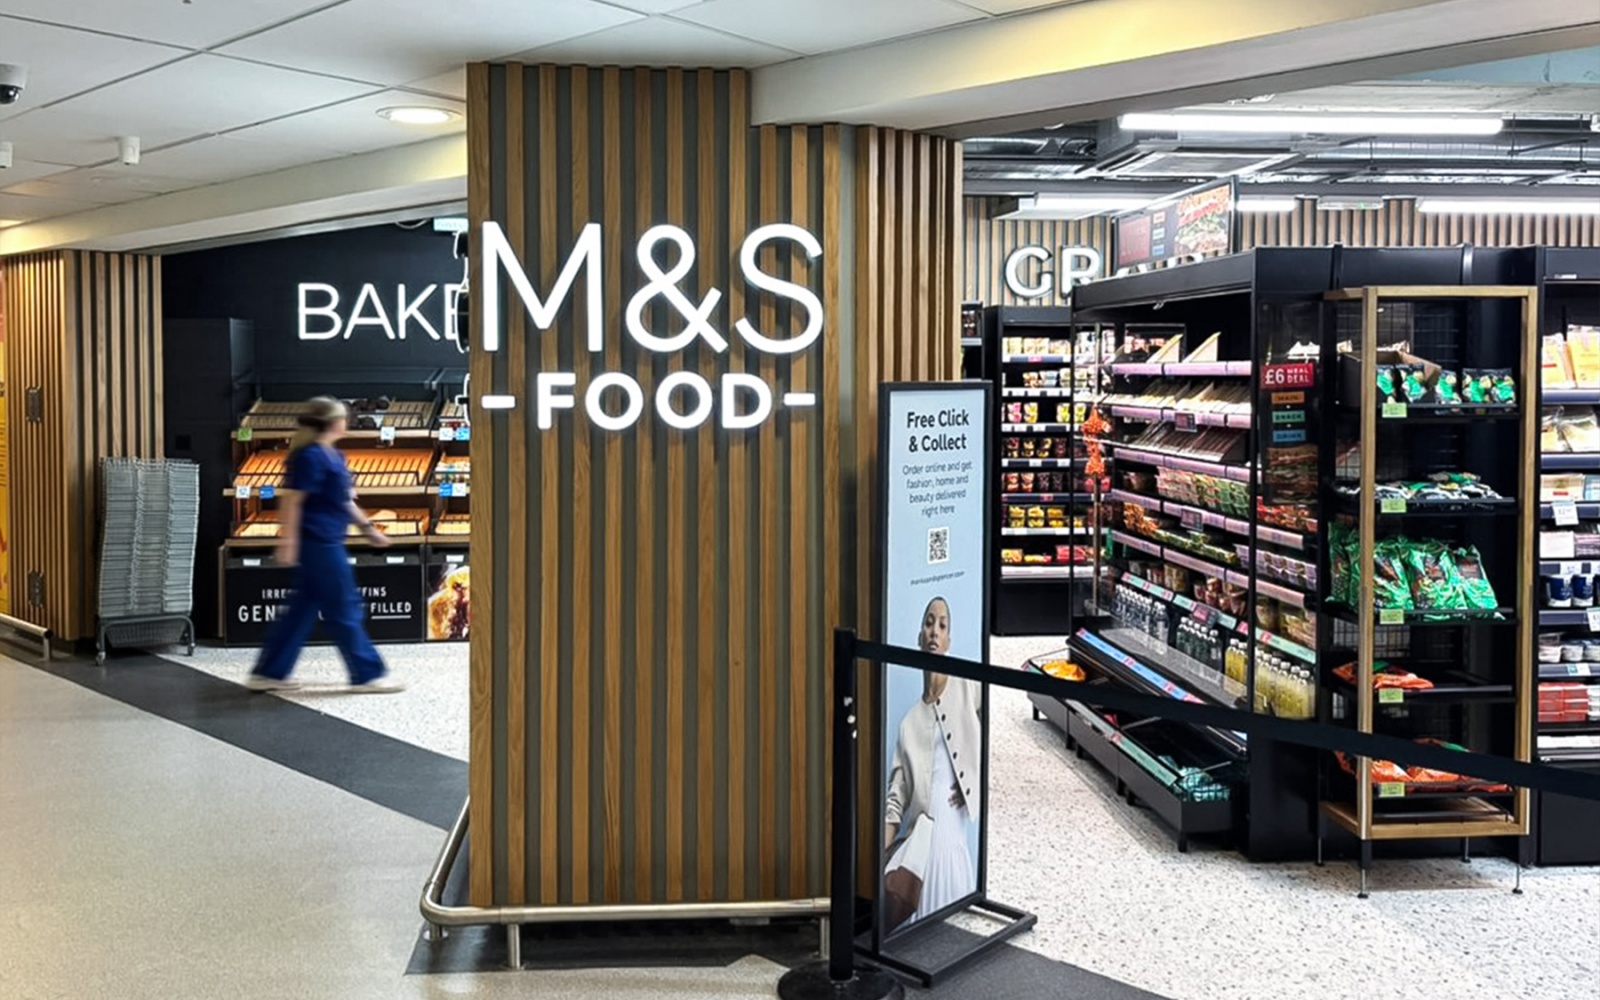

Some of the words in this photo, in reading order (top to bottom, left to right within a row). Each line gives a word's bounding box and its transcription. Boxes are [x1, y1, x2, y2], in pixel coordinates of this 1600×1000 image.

[482, 221, 824, 353] M&S
[1265, 368, 1285, 385] £6
[1287, 374, 1309, 384] DEAL
[906, 411, 935, 429] Free
[938, 408, 970, 427] Click
[908, 435, 918, 453] &
[921, 433, 967, 452] Collect
[902, 463, 924, 475] Order
[925, 462, 946, 473] online
[947, 461, 960, 471] and
[961, 461, 972, 472] get
[906, 478, 935, 489] fashion,
[935, 477, 955, 486] home
[956, 475, 969, 484] and
[909, 492, 934, 504] beauty
[935, 489, 967, 501] delivered
[921, 504, 938, 518] right
[940, 504, 955, 514] here
[262, 588, 294, 599] IRRE
[370, 601, 412, 613] FILLED
